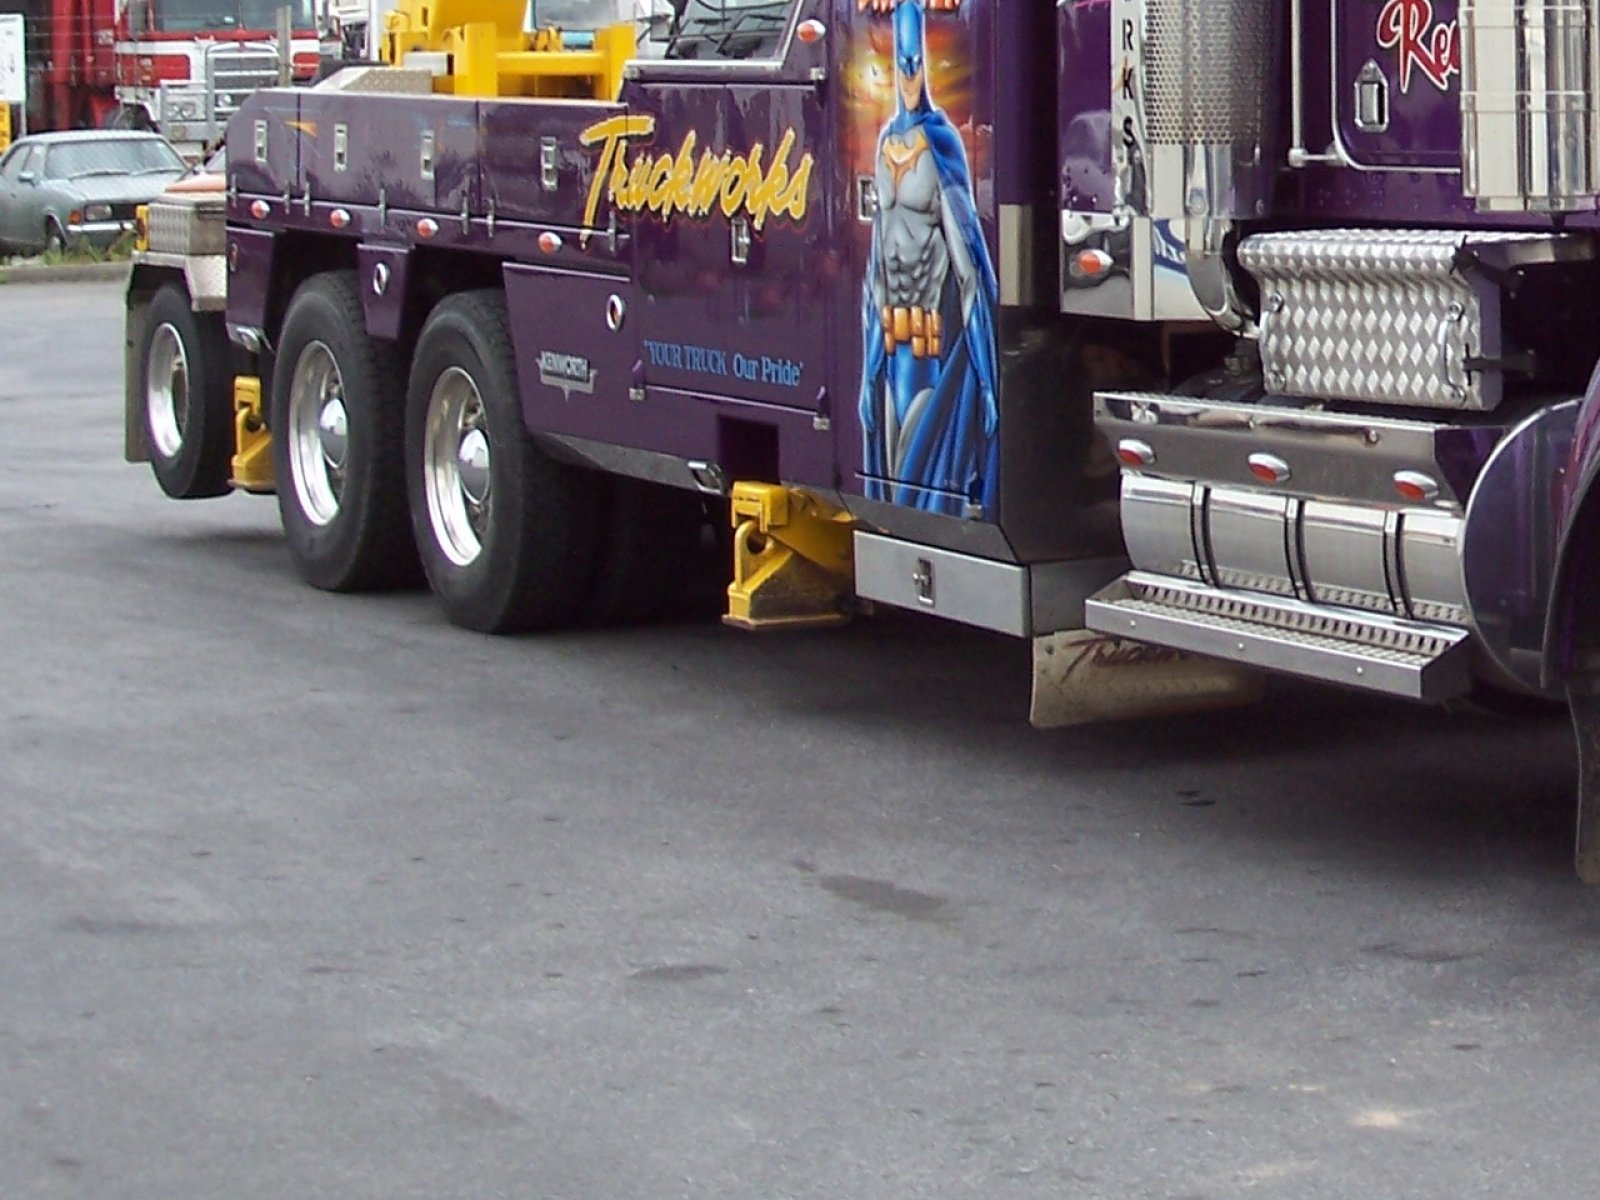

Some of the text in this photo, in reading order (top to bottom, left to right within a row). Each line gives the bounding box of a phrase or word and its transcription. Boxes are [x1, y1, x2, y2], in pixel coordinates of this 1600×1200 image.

[580, 114, 814, 250] Truckworks
[684, 344, 728, 377] TRUCK
[733, 353, 758, 381] Our
